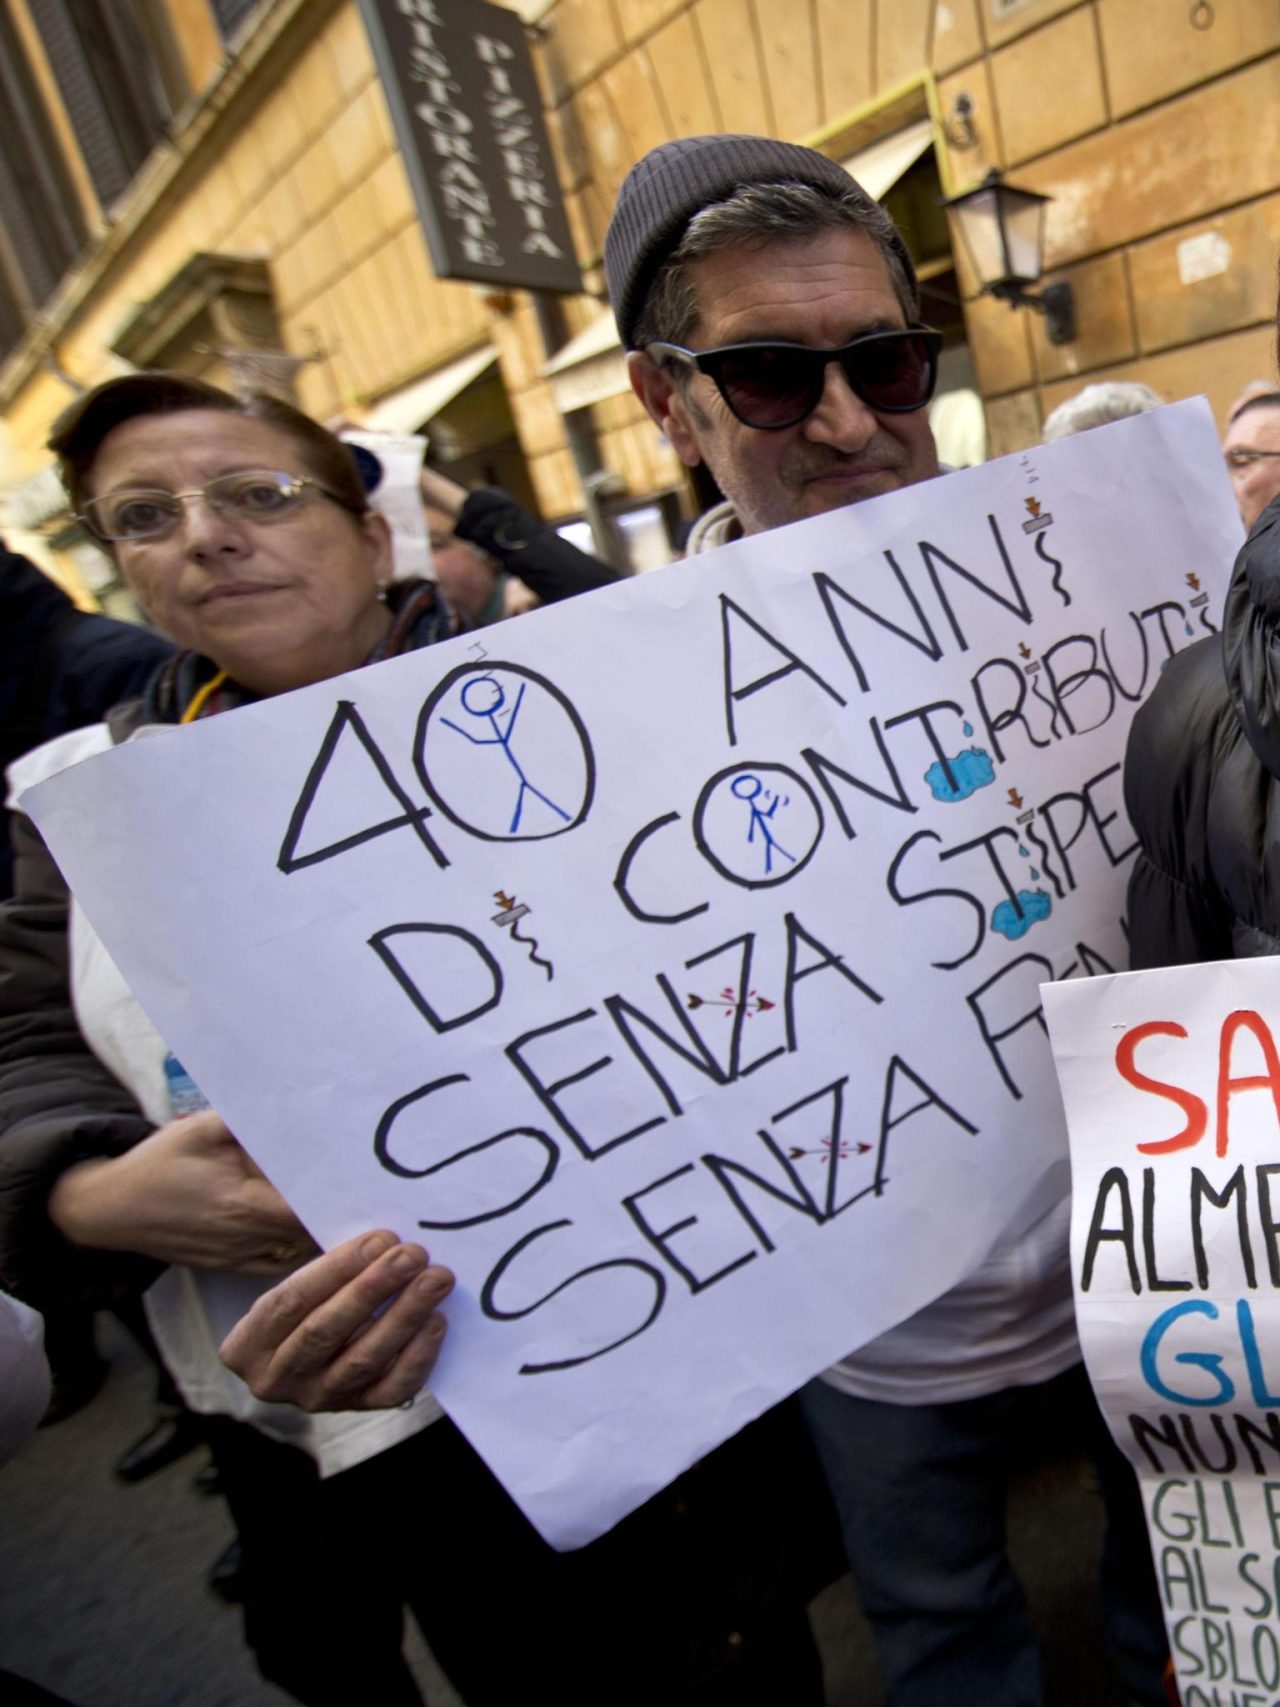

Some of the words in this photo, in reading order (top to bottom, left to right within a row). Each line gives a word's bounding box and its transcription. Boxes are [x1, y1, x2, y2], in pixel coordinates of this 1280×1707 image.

[474, 33, 564, 260] PIZZERIA
[277, 660, 596, 875] 40
[374, 911, 885, 1230] SENZA
[479, 1053, 980, 1375] SENZA
[1152, 1479, 1244, 1549] GLI
[1160, 1545, 1229, 1614] AL
